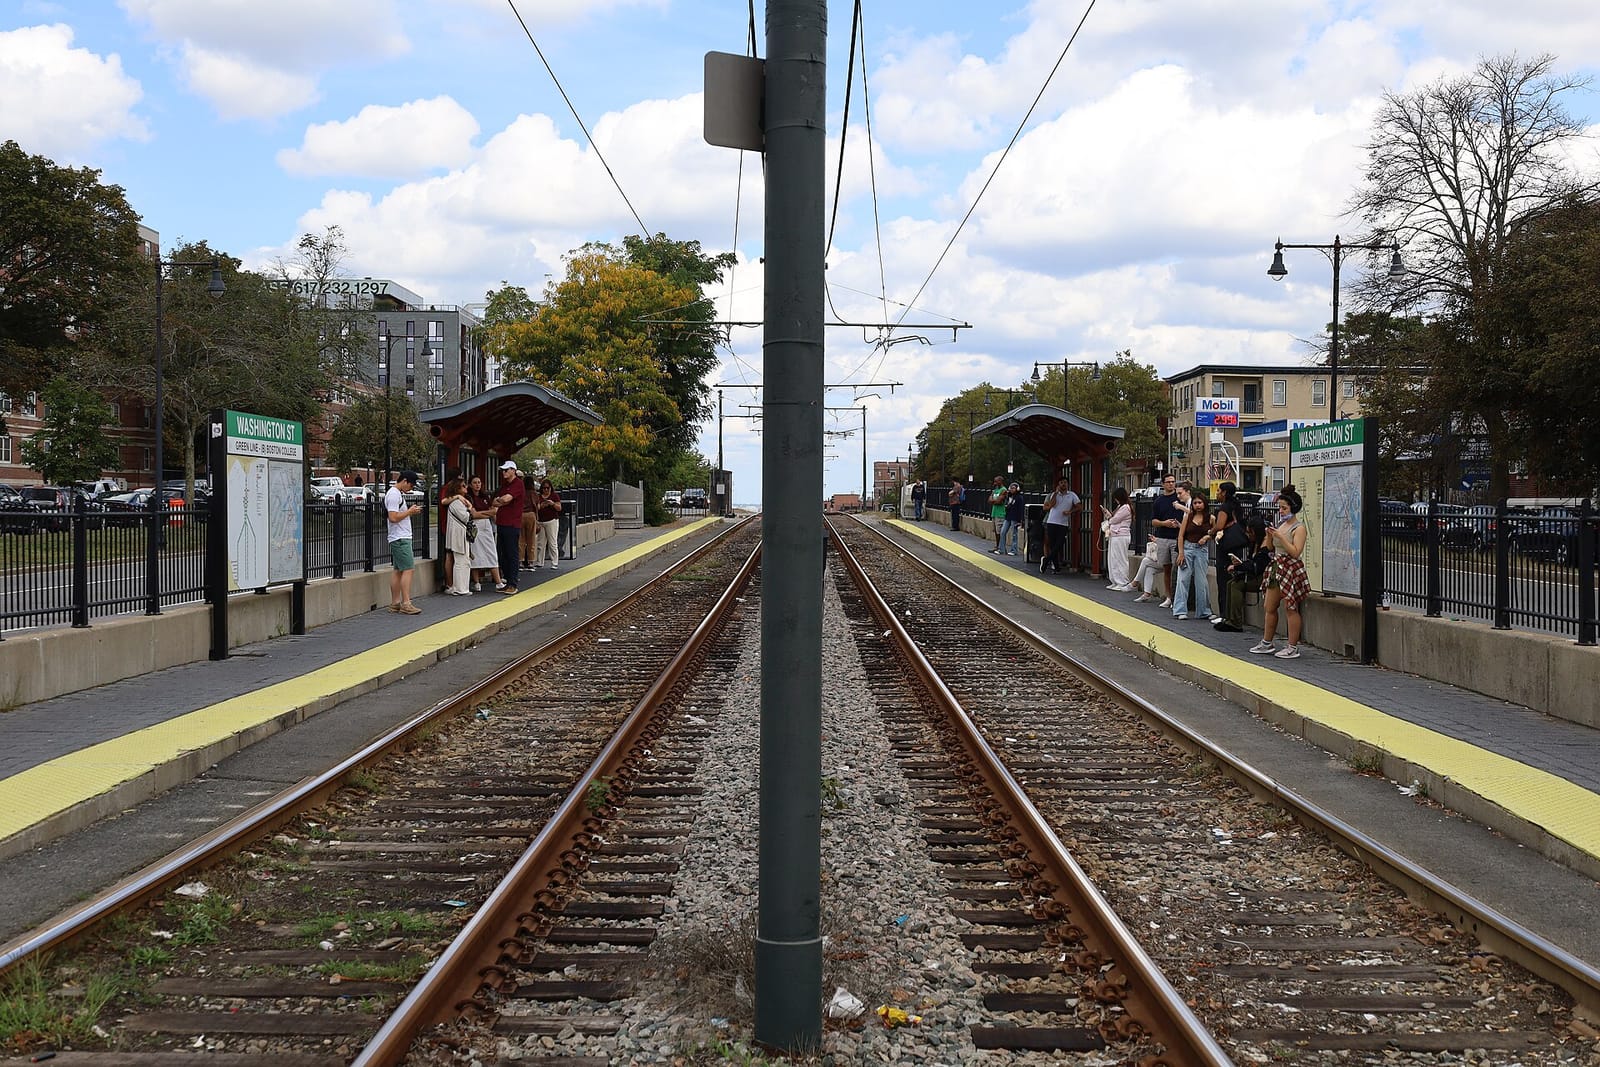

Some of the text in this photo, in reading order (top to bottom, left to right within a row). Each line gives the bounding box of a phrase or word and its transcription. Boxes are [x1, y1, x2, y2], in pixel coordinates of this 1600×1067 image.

[294, 281, 388, 295] 617232.1297
[1202, 400, 1233, 410] Mobil
[236, 416, 295, 441] WASHINGTON ST
[1299, 423, 1354, 449] WASHINGTON ST
[235, 441, 249, 451] GREEN
[250, 442, 259, 453] LINE
[267, 444, 281, 455] BOSTON
[281, 446, 297, 457] COLLEGE
[1300, 454, 1310, 464] GREEN
[1311, 452, 1319, 462] LINE
[1321, 451, 1330, 461] PARK
[1331, 450, 1335, 460] ST
[1340, 448, 1352, 460] NORTH
